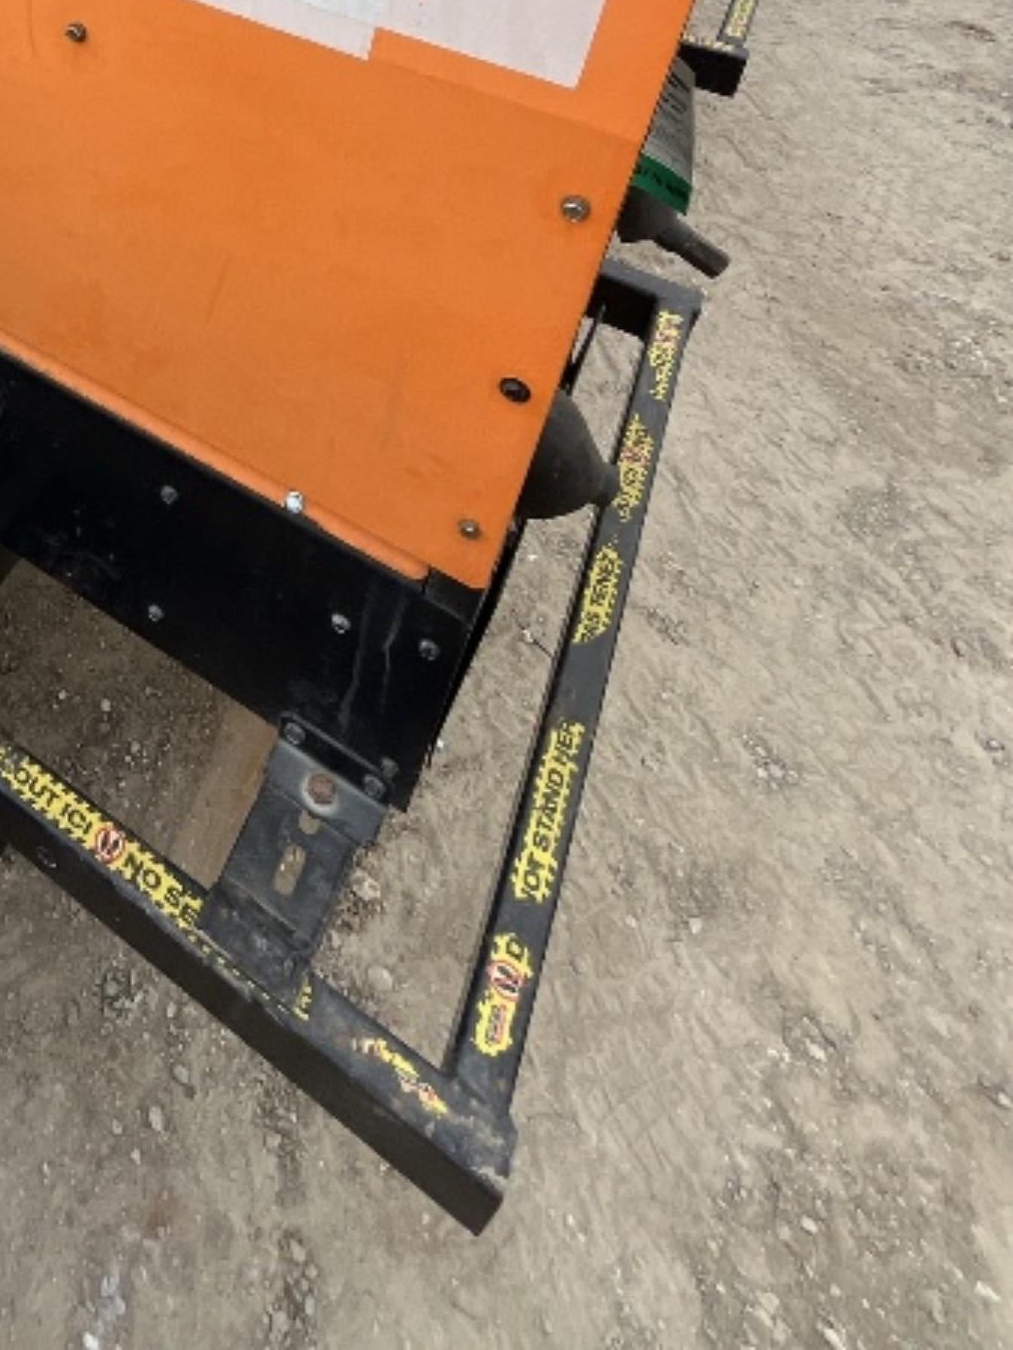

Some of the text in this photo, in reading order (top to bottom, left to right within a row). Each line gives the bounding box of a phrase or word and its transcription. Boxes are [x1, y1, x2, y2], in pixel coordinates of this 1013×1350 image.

[60, 803, 93, 834] ICI
[123, 853, 162, 890] NO
[533, 767, 565, 852] STAND
